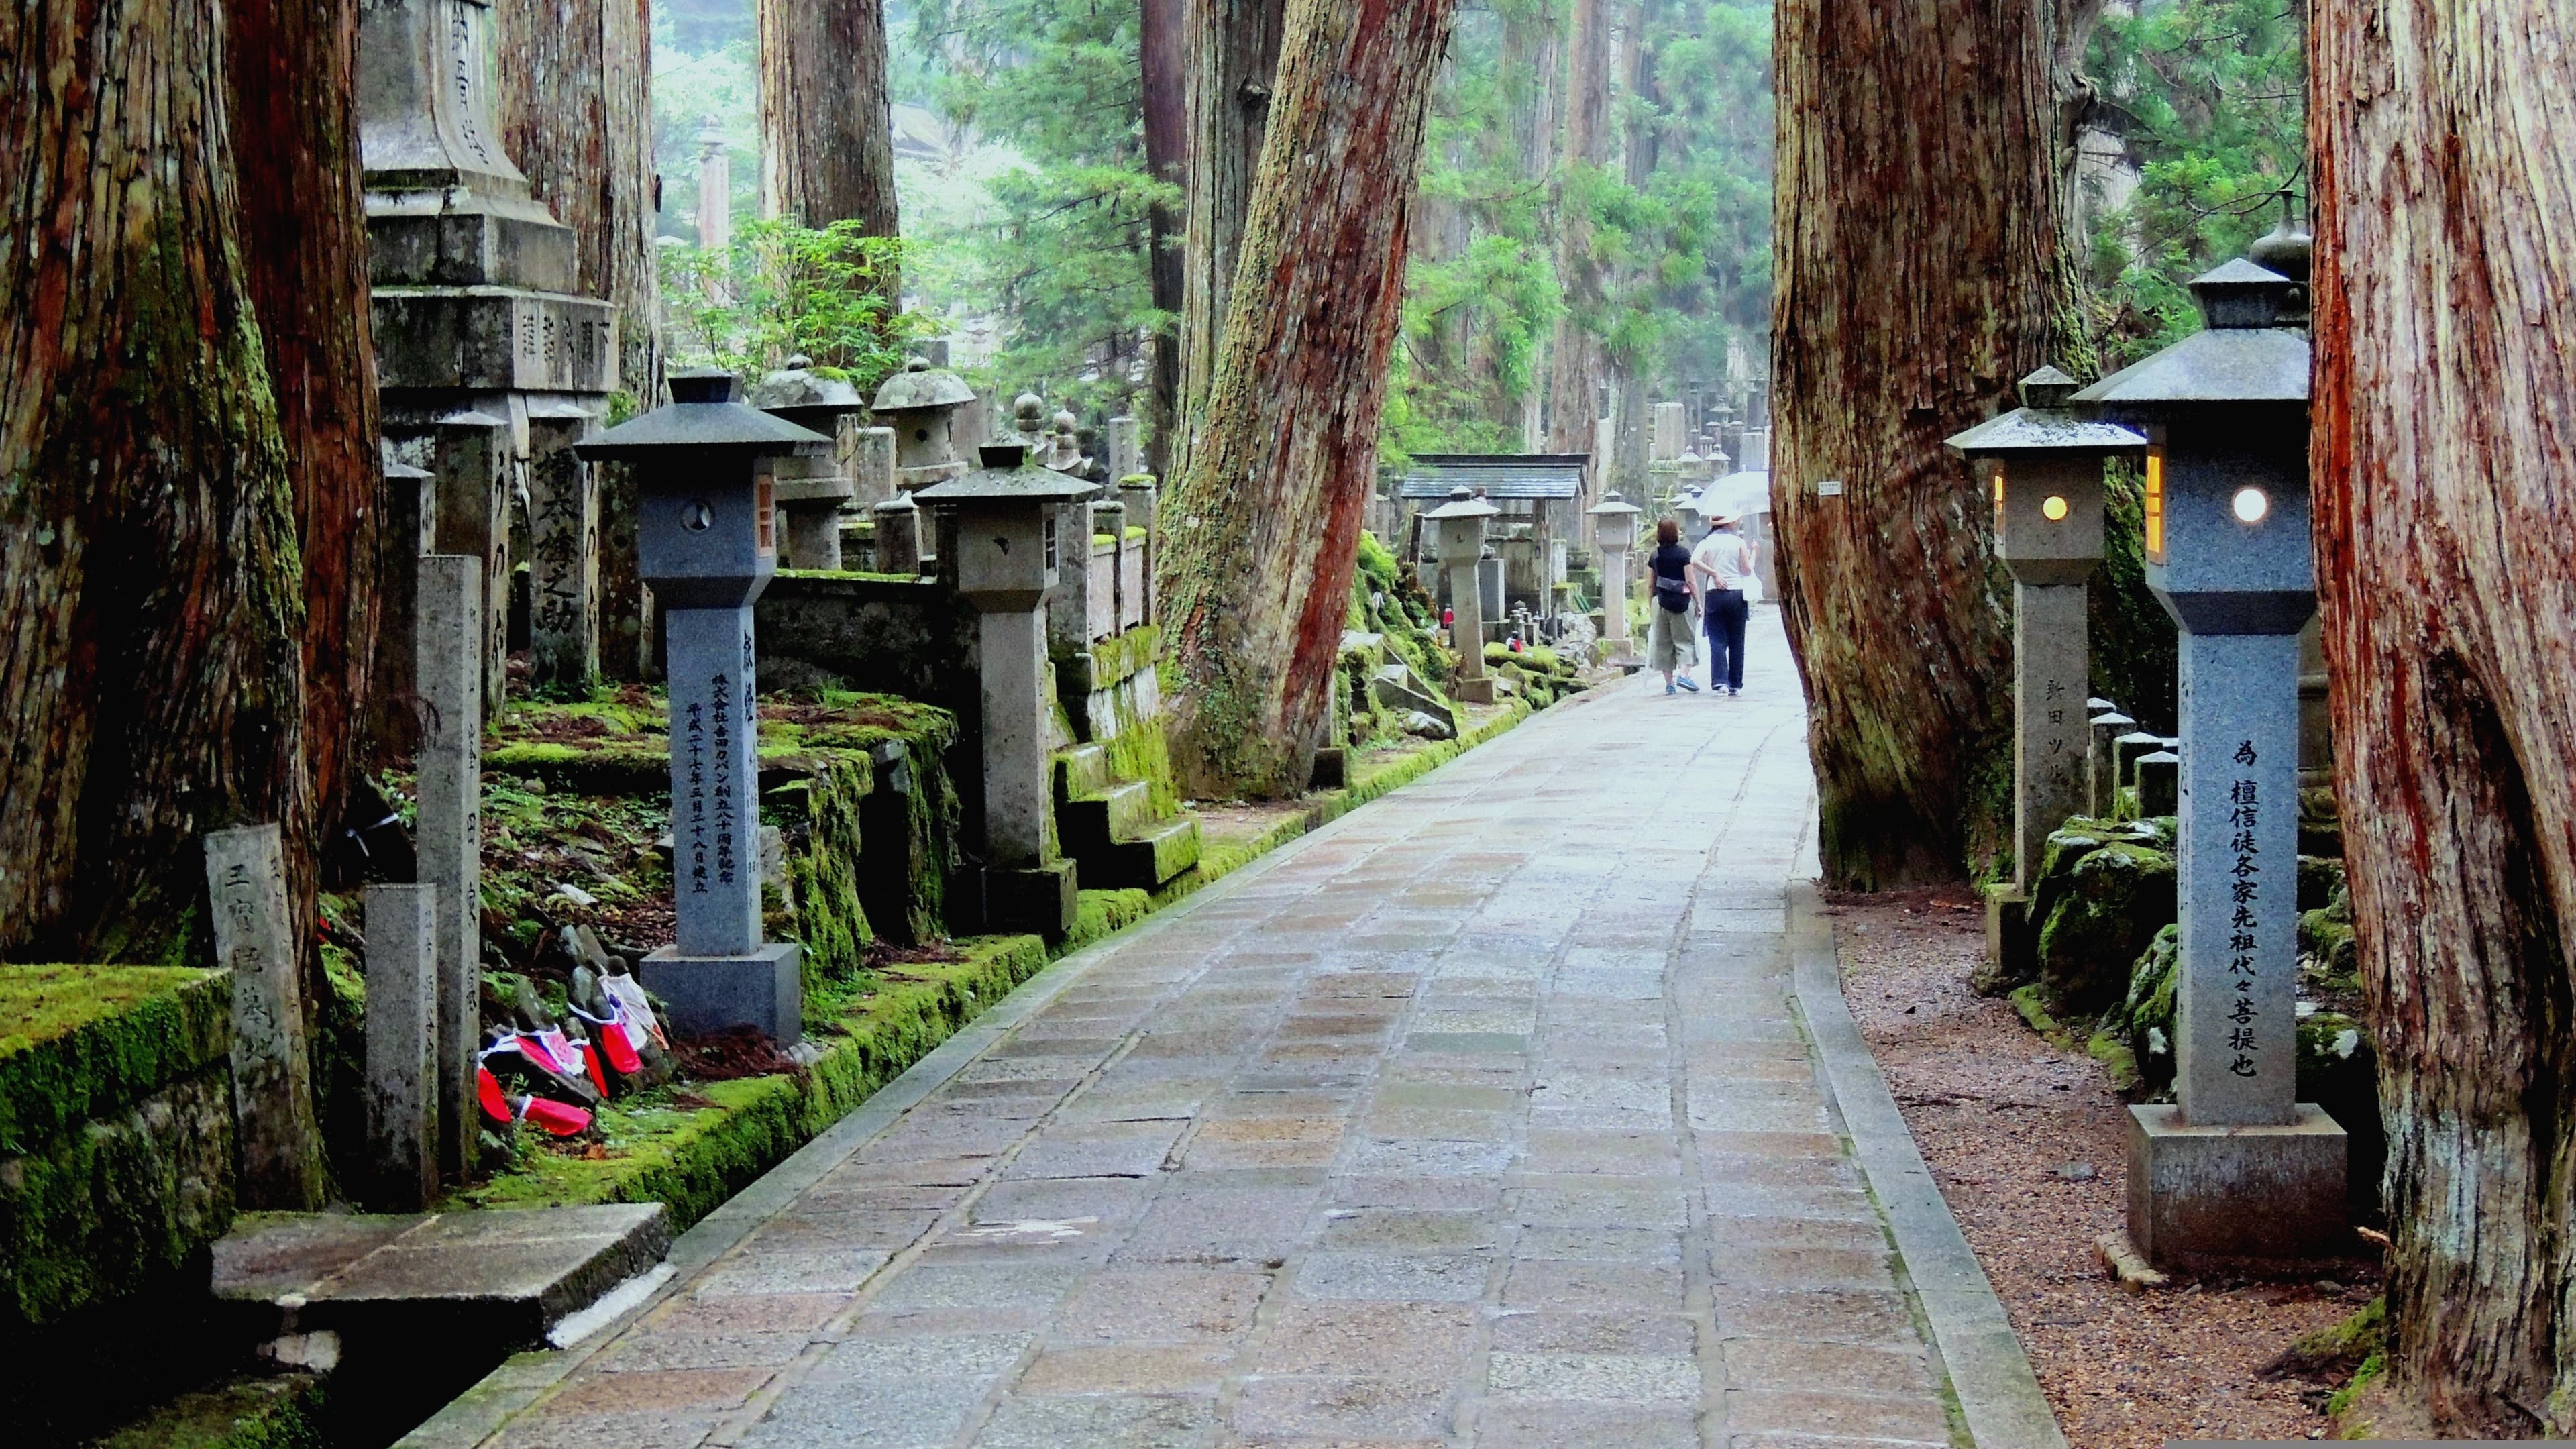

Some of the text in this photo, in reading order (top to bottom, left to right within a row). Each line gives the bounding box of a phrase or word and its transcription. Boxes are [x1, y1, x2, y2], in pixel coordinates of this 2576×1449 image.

[686, 702, 708, 894] 平成二十七年三月二十八日建立
